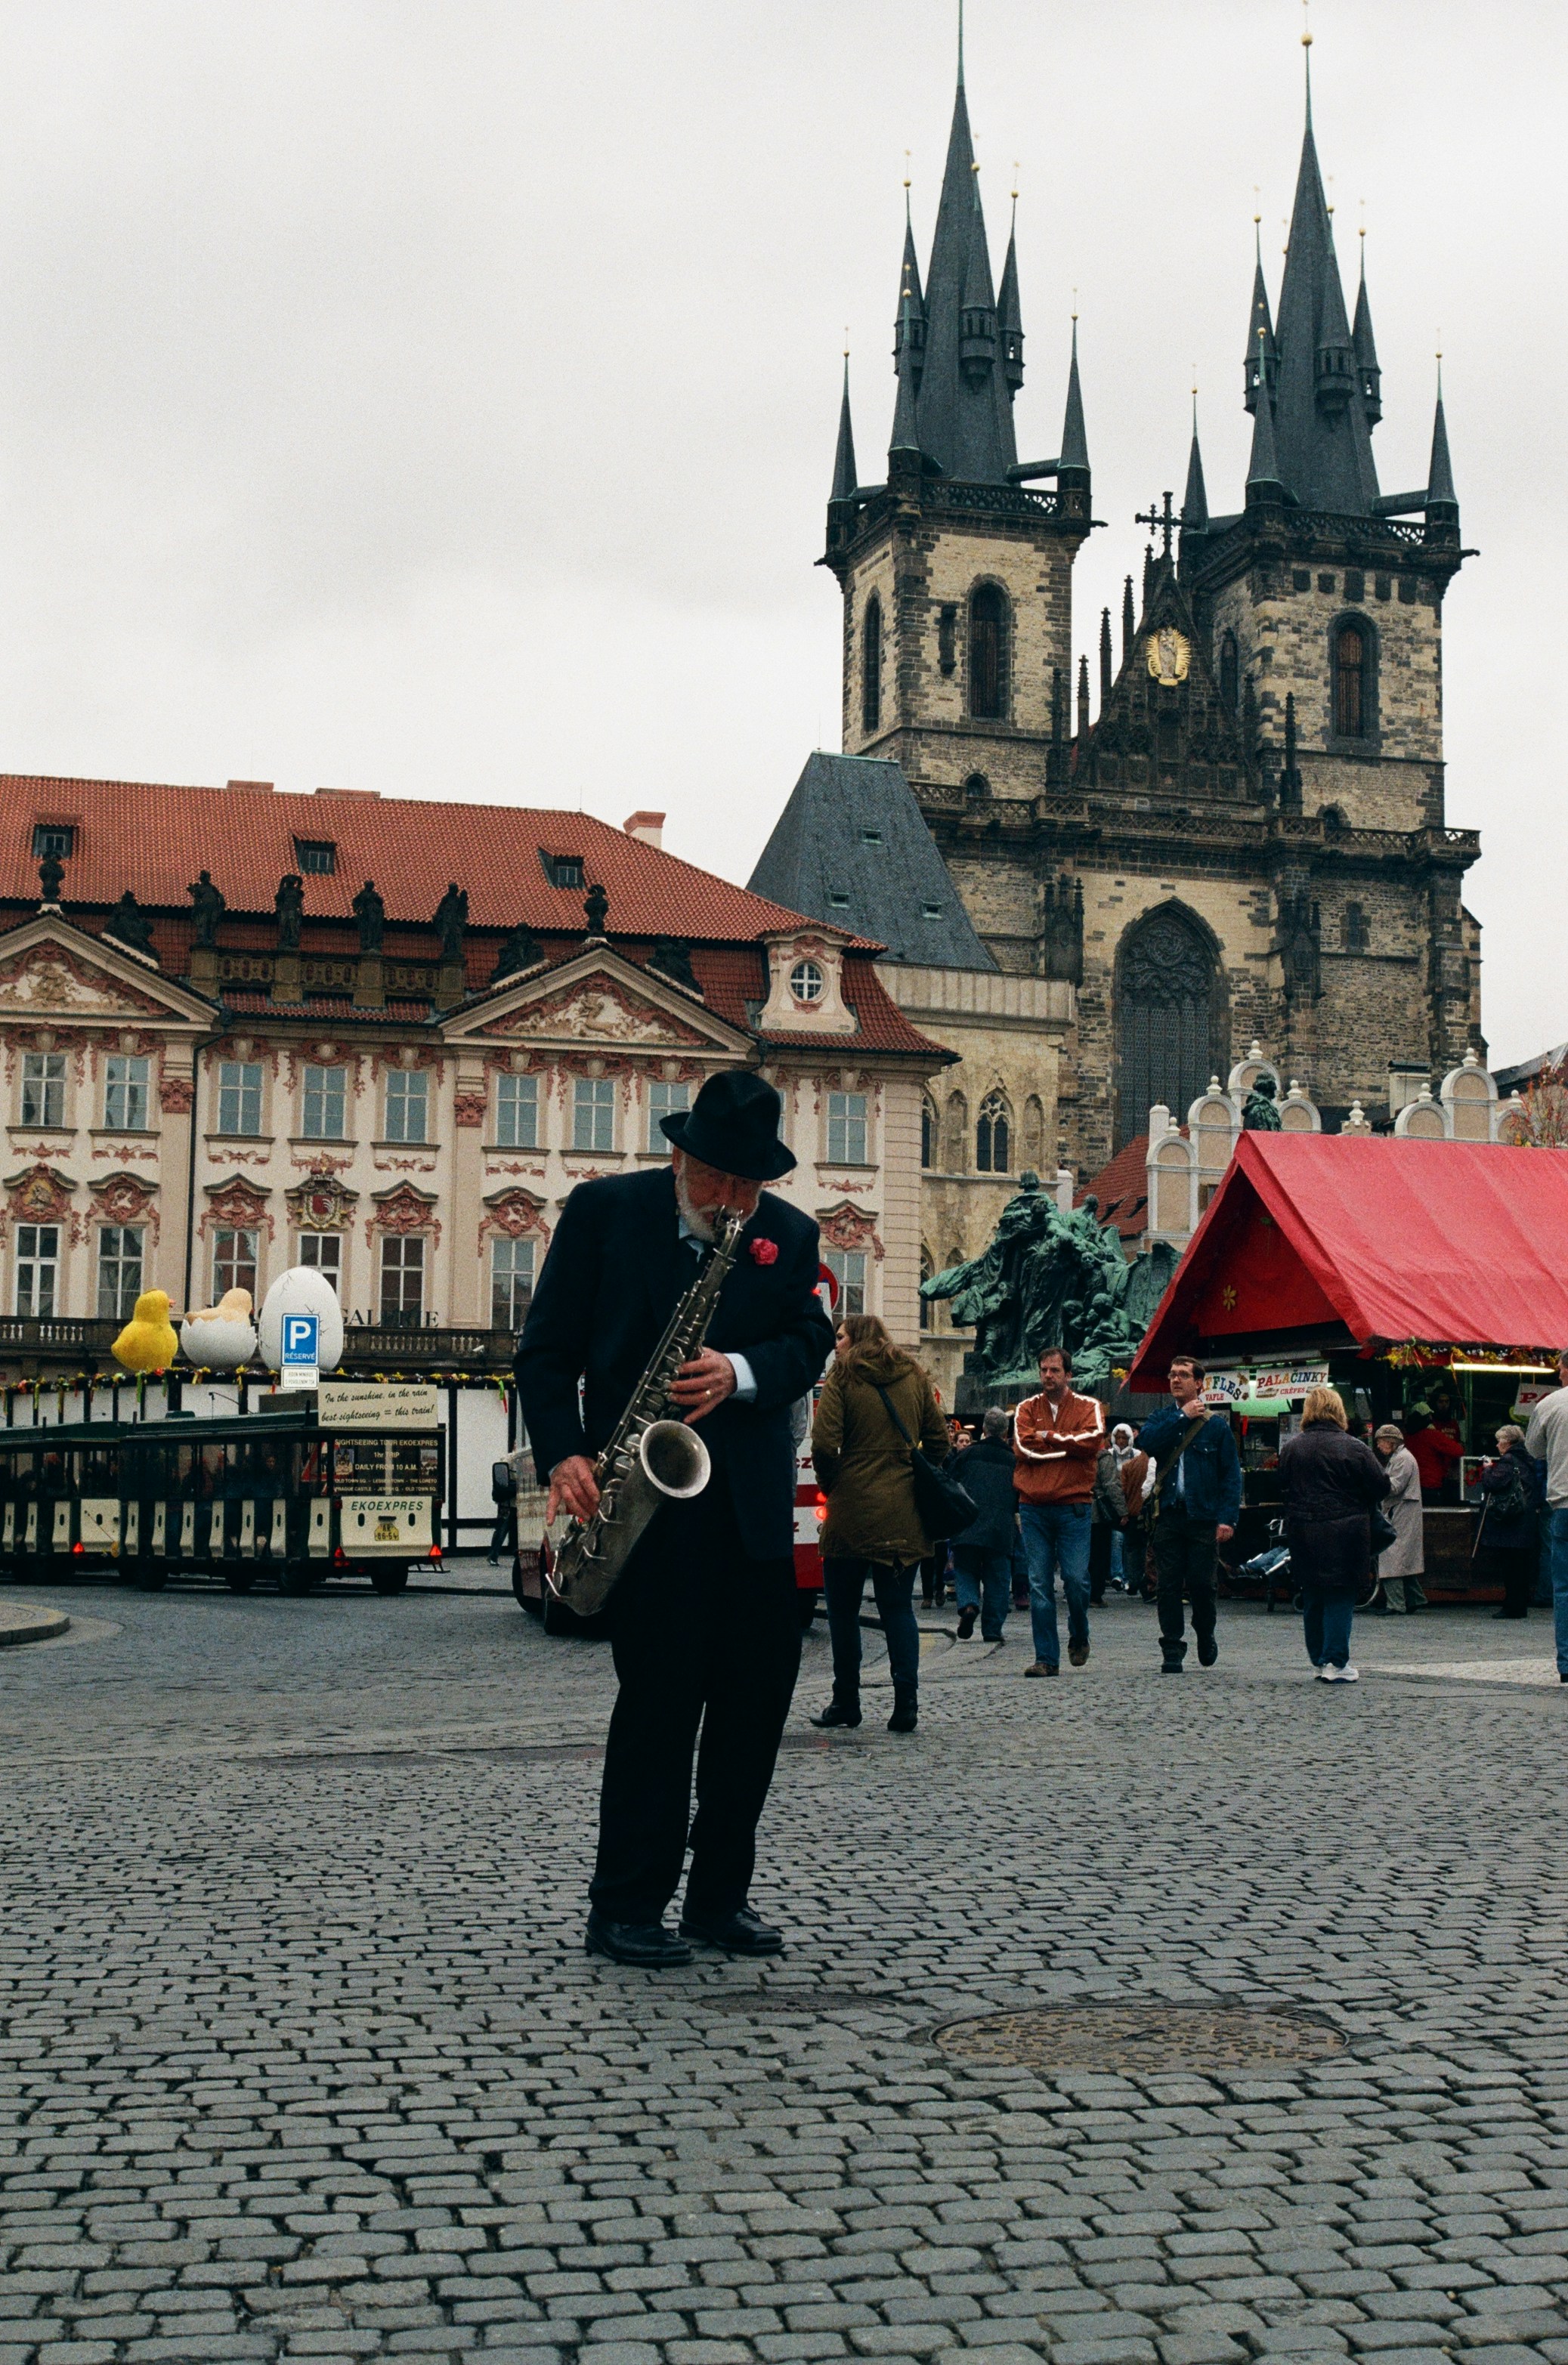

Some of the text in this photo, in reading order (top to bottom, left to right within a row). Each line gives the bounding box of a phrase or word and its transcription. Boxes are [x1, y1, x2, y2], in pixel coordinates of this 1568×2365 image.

[290, 1321, 311, 1349] P
[285, 1352, 315, 1360] RÉSERVÉ
[1257, 1369, 1327, 1389] PALAČINKY
[325, 1393, 335, 1403] In
[337, 1393, 348, 1402] the
[398, 1388, 410, 1397] the
[412, 1389, 428, 1397] rain
[1205, 1393, 1224, 1402] VAFLE
[321, 1411, 336, 1422] best
[339, 1410, 381, 1423] sightseeing
[394, 1406, 409, 1416] this
[411, 1404, 435, 1415] train!
[351, 1501, 423, 1511] EKOEXPRES
